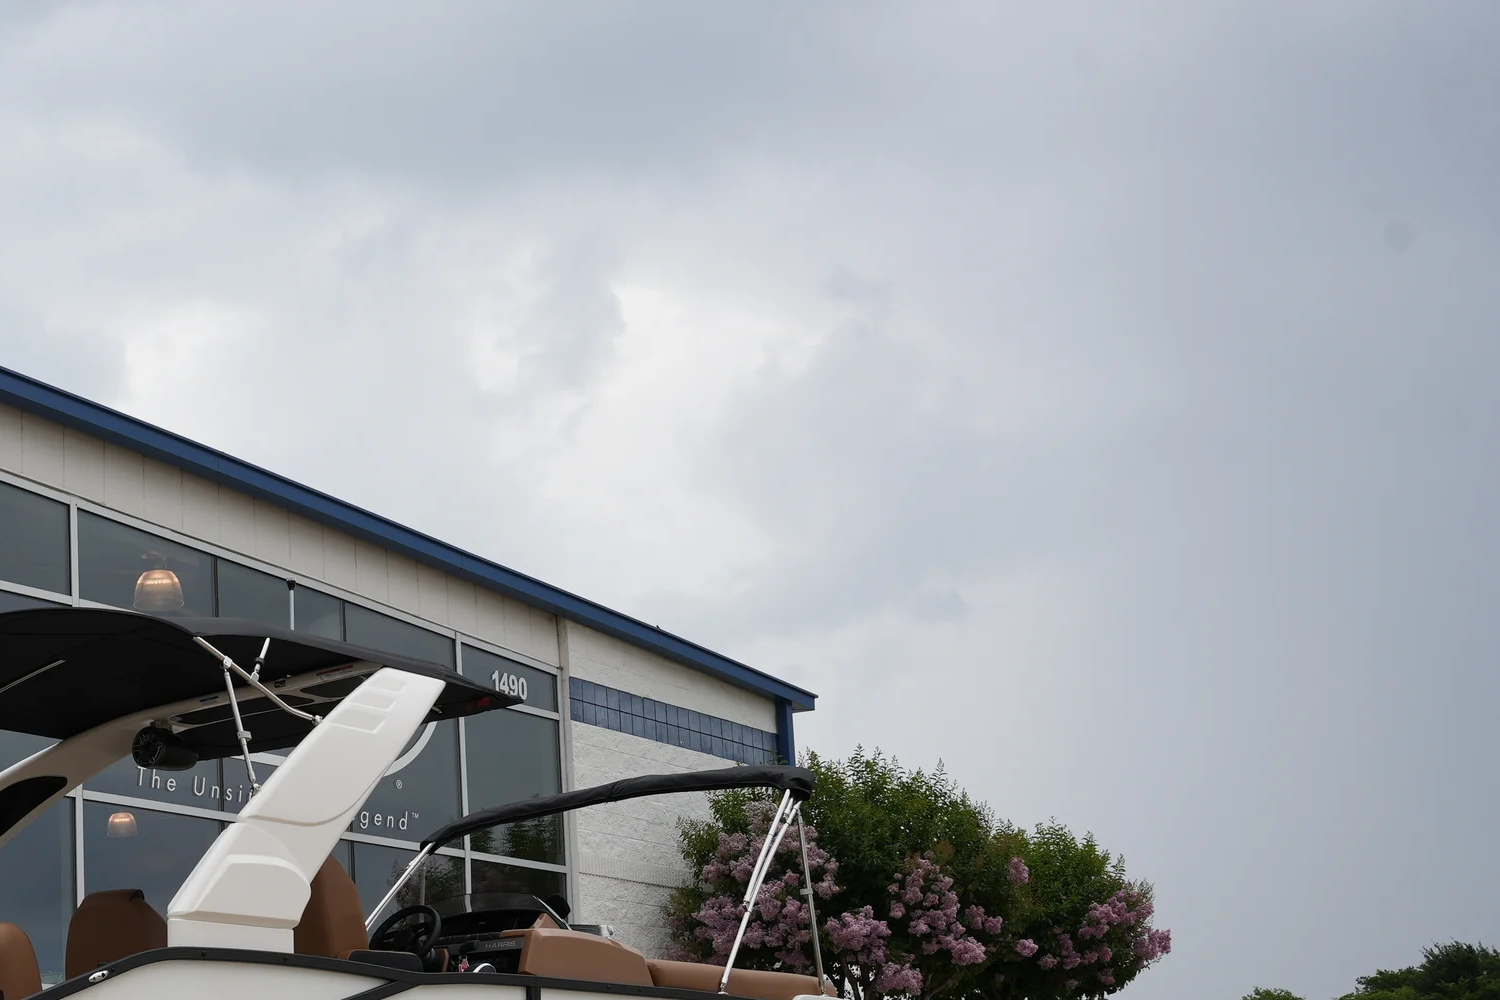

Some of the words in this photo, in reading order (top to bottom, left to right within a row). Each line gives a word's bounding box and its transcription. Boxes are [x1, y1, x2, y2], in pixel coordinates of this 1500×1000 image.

[491, 669, 528, 701] 1490
[137, 765, 177, 792] The
[485, 940, 517, 950] HARRIS
